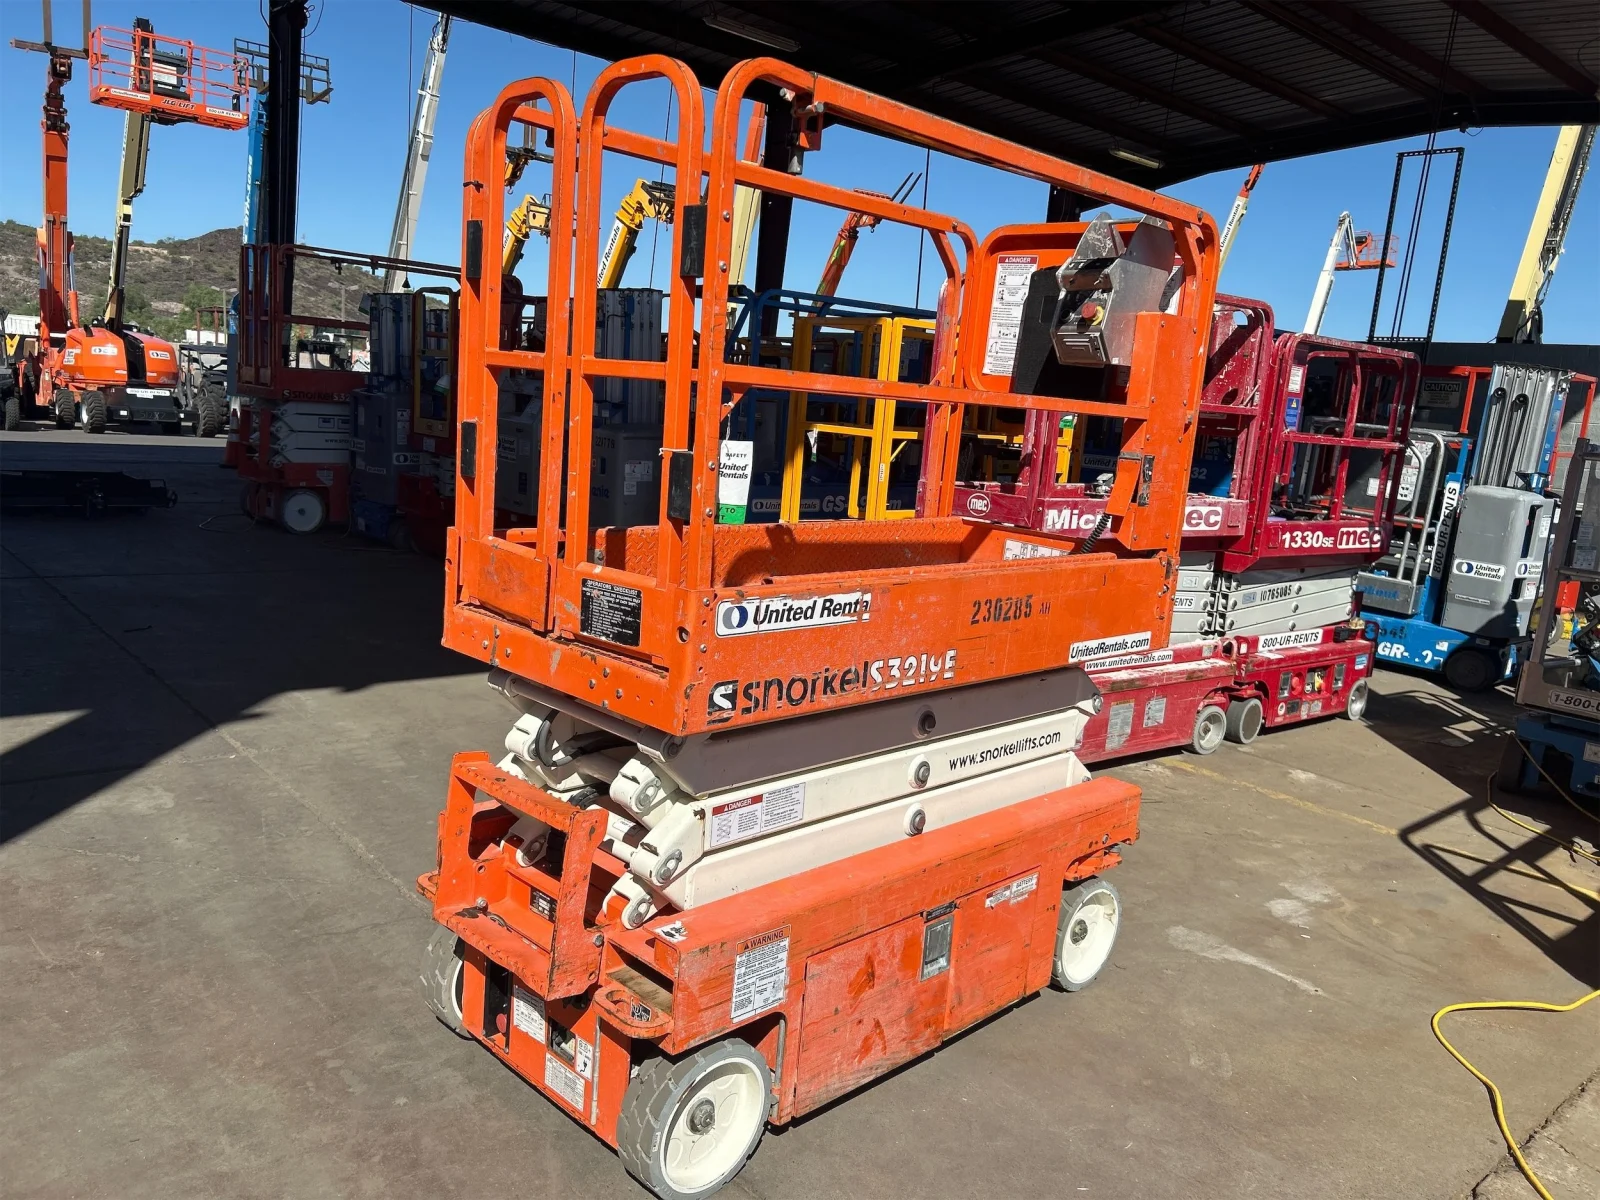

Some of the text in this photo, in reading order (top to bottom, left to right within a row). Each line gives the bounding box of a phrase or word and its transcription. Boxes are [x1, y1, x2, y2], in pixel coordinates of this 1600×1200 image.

[162, 98, 196, 110] JLG LIFT
[604, 225, 621, 262] Rentals
[1425, 382, 1460, 392] CAUTION
[718, 463, 748, 472] United
[1084, 457, 1112, 468] United
[718, 471, 748, 480] Rentals
[592, 485, 610, 498] enie
[970, 498, 988, 512] mec
[1474, 563, 1501, 574] United
[1474, 570, 1502, 580] Rentals
[1174, 598, 1193, 606] ENTS
[752, 602, 814, 626] United
[1262, 632, 1320, 648] 800-UR-RENTS
[1070, 637, 1150, 659] UnitedRentals.com
[1086, 652, 1172, 670] www.unitedrentals.com
[949, 730, 1061, 771] www.snorkellifts.com
[728, 798, 752, 811] DANGER
[750, 930, 784, 948] WARNING
